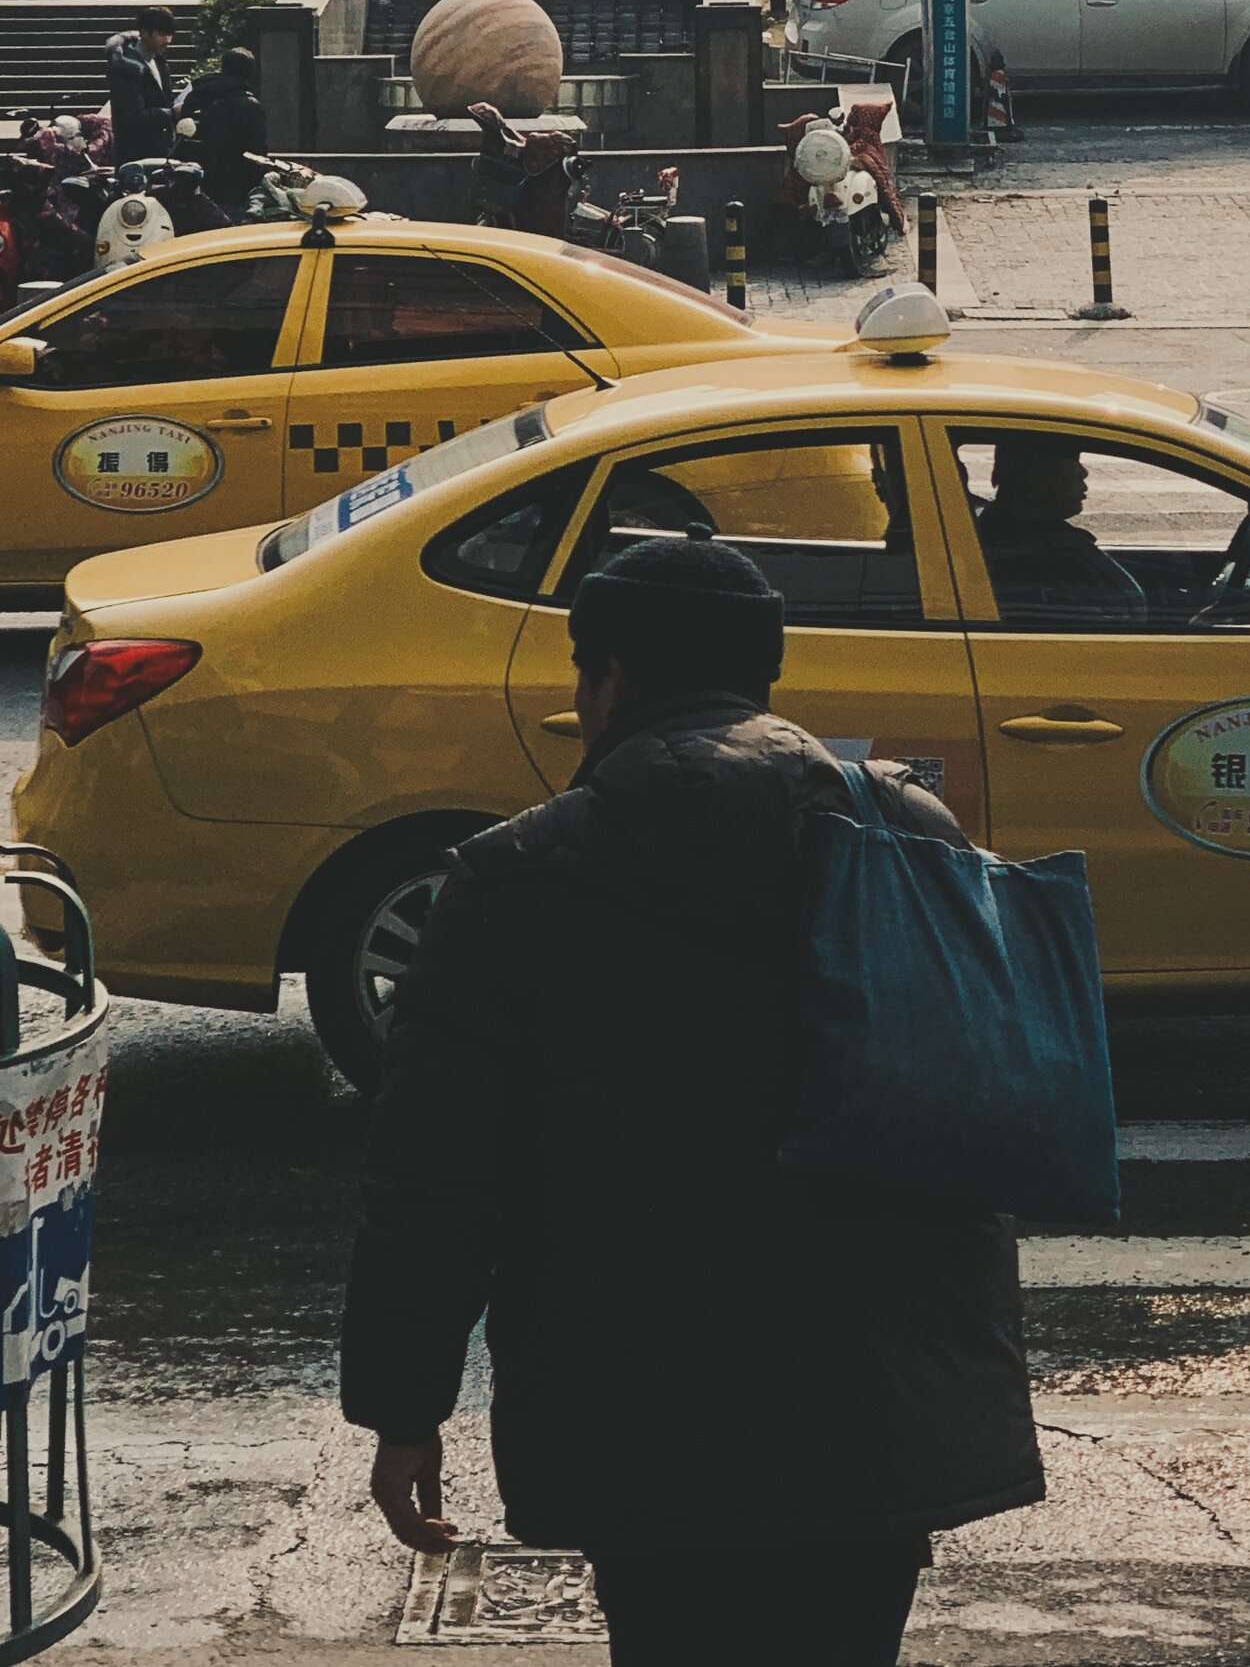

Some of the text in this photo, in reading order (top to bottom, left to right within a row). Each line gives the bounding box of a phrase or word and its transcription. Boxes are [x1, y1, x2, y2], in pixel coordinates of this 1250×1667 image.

[88, 423, 192, 445] NANJING TAXI
[120, 481, 188, 498] 96520
